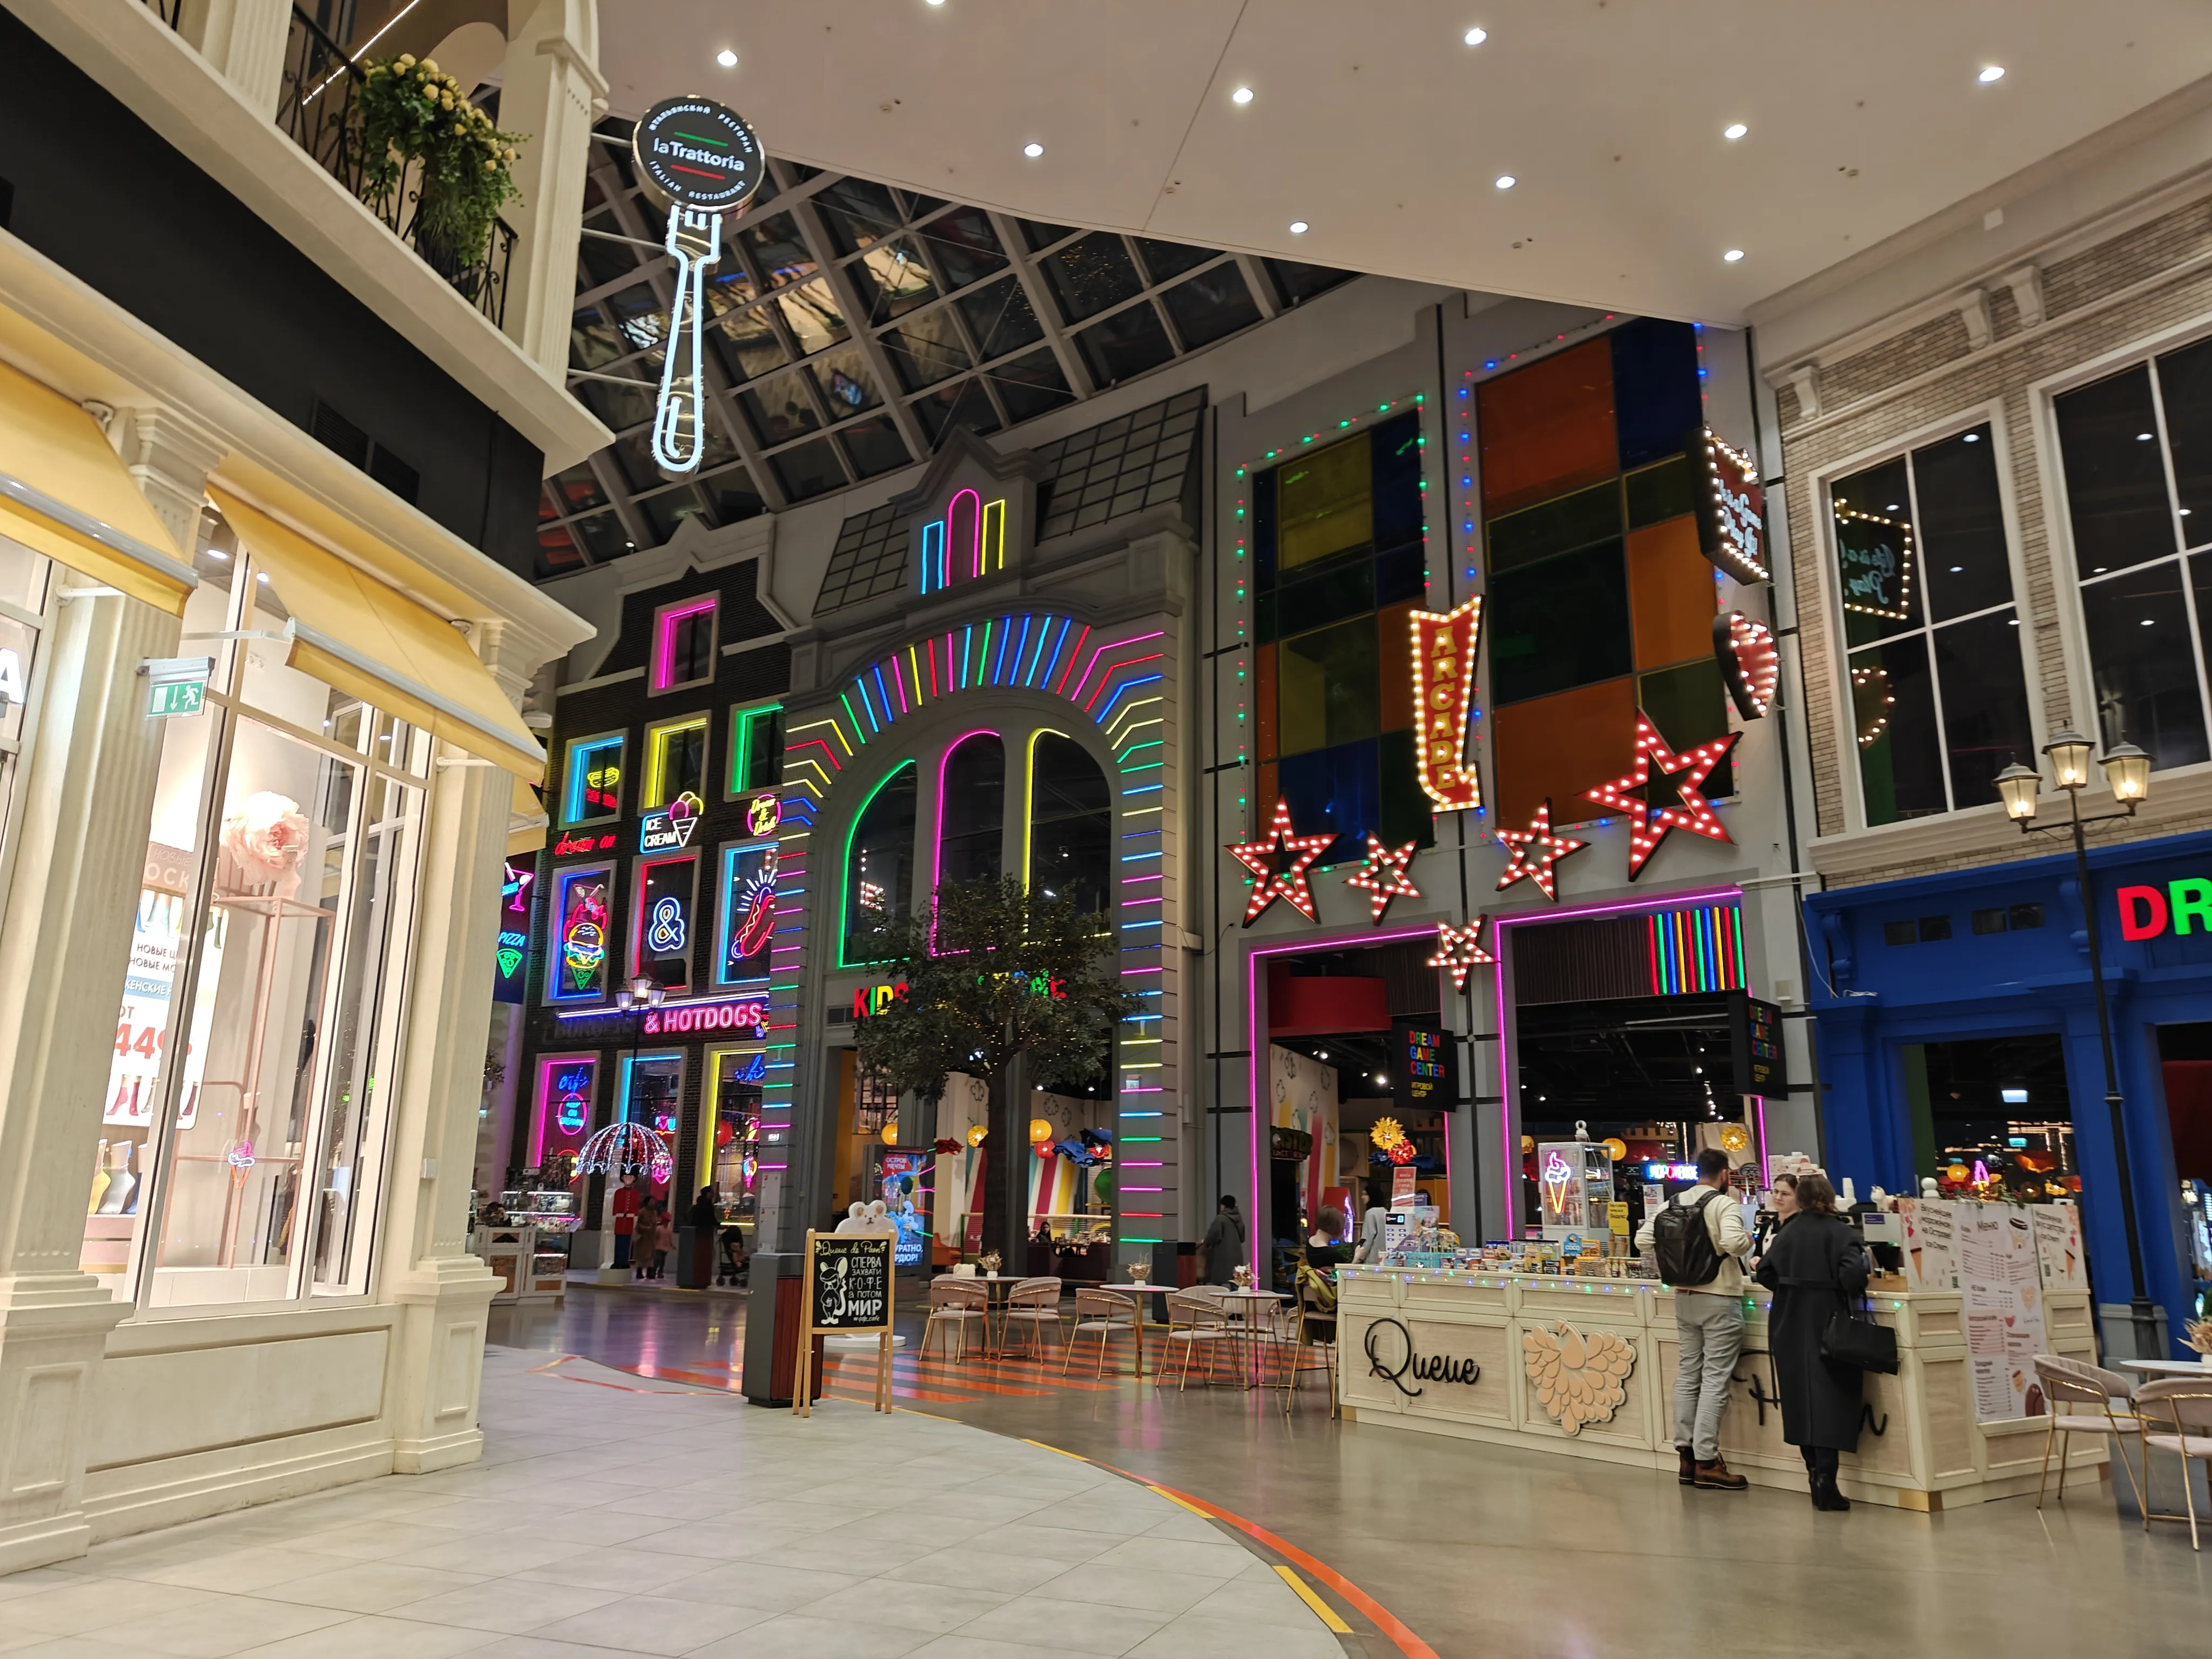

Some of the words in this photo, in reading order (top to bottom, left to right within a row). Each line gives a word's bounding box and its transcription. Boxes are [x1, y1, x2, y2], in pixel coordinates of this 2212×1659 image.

[717, 113, 753, 153] РЕСТОРАН
[649, 160, 682, 192] ITALIAN
[688, 180, 746, 200] RESTAURANT
[1429, 625, 1459, 791] ARCADE
[645, 817, 663, 831] ICE
[644, 831, 676, 847] CREAM
[497, 932, 526, 947] PIZZA
[136, 942, 168, 957] НОВЫЕ
[663, 1003, 763, 1033] HOTDOGS
[1409, 1029, 1440, 1048] DREAM
[1410, 1045, 1436, 1062] GAME
[1410, 1060, 1445, 1078] CENTER
[885, 1156, 907, 1164] ОСТРОВ
[851, 1256, 882, 1269] СПЕРВА
[851, 1268, 882, 1276] ЗАХВАТИ
[847, 1299, 883, 1317] МИР
[1364, 1318, 1481, 1397] Queue
